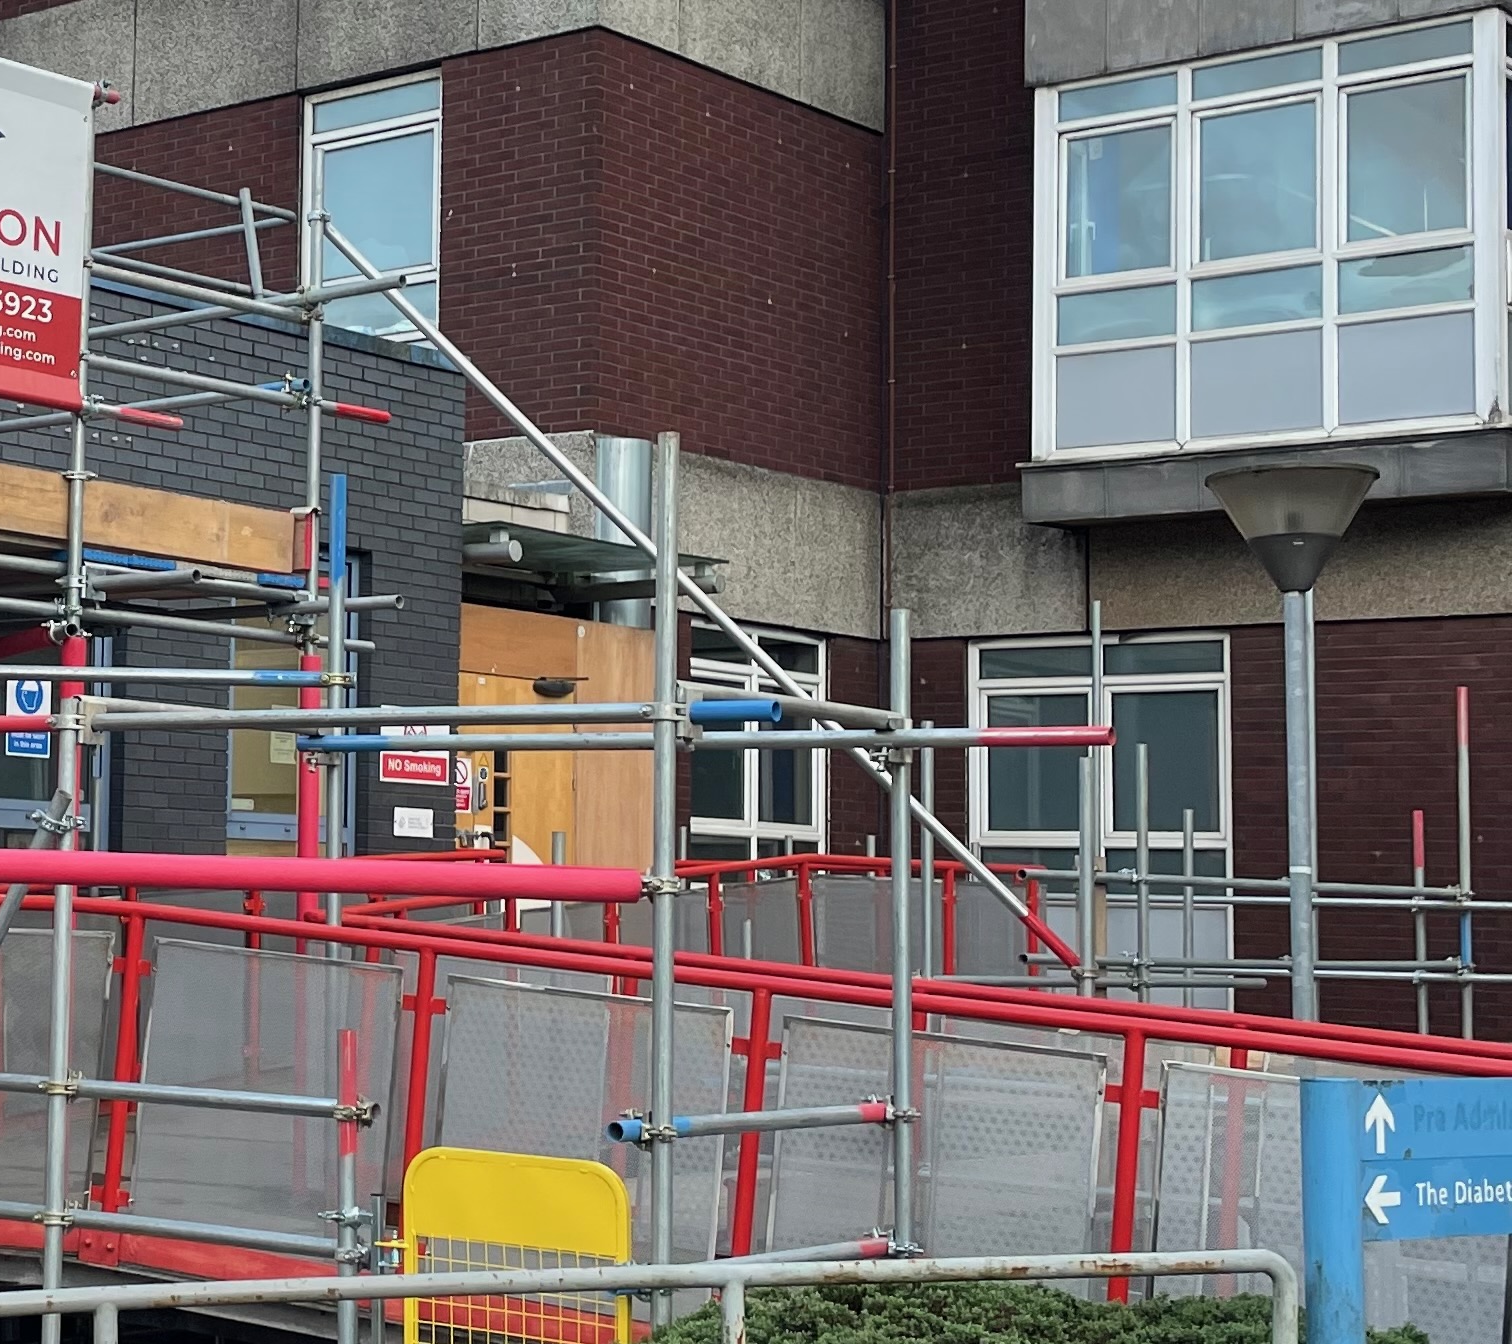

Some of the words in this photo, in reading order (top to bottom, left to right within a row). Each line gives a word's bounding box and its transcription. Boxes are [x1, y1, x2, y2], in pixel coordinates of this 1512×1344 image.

[388, 758, 402, 772] NO
[403, 759, 442, 777] Smoking
[1415, 1181, 1448, 1206] The
